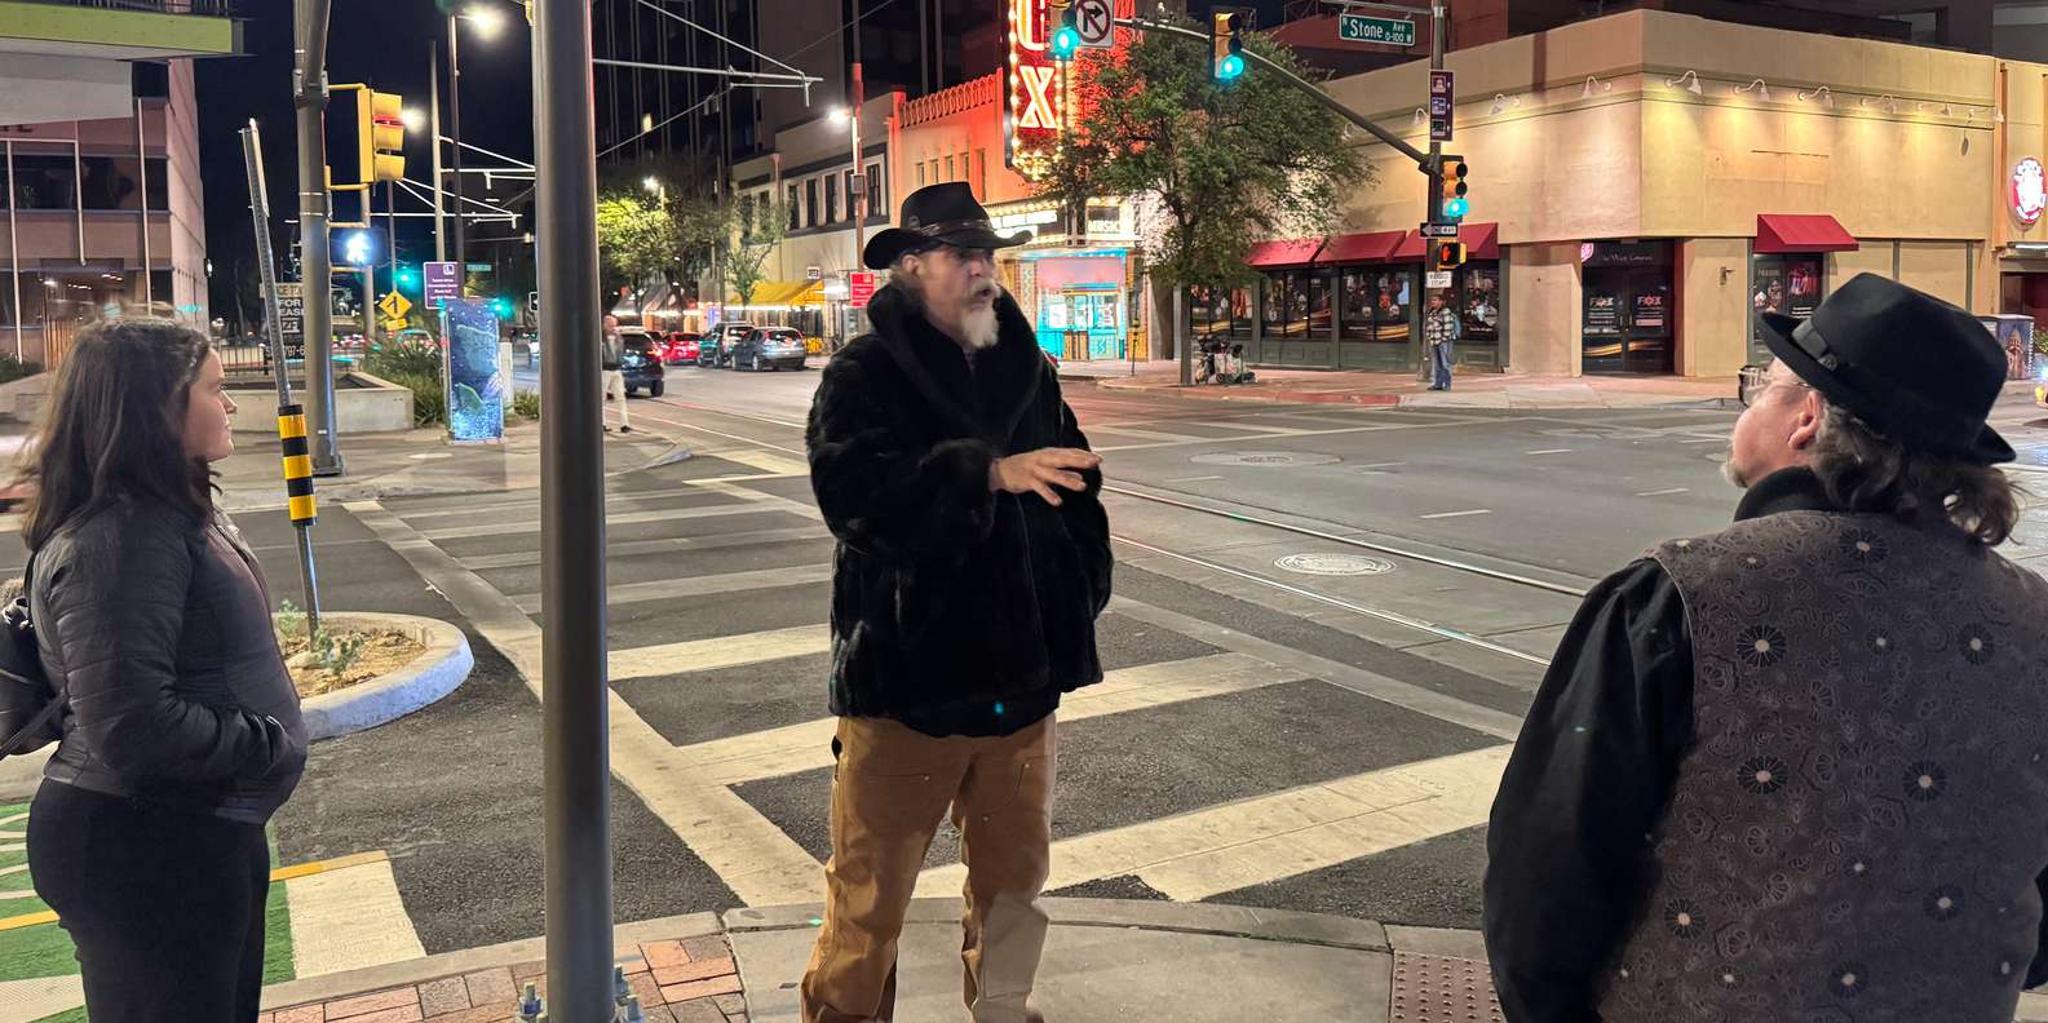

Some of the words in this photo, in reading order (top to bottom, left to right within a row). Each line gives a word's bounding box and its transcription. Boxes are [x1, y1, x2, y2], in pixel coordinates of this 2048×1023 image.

[1350, 18, 1383, 38] Stone
[1392, 22, 1405, 32] Ave
[1637, 294, 1662, 306] FOX
